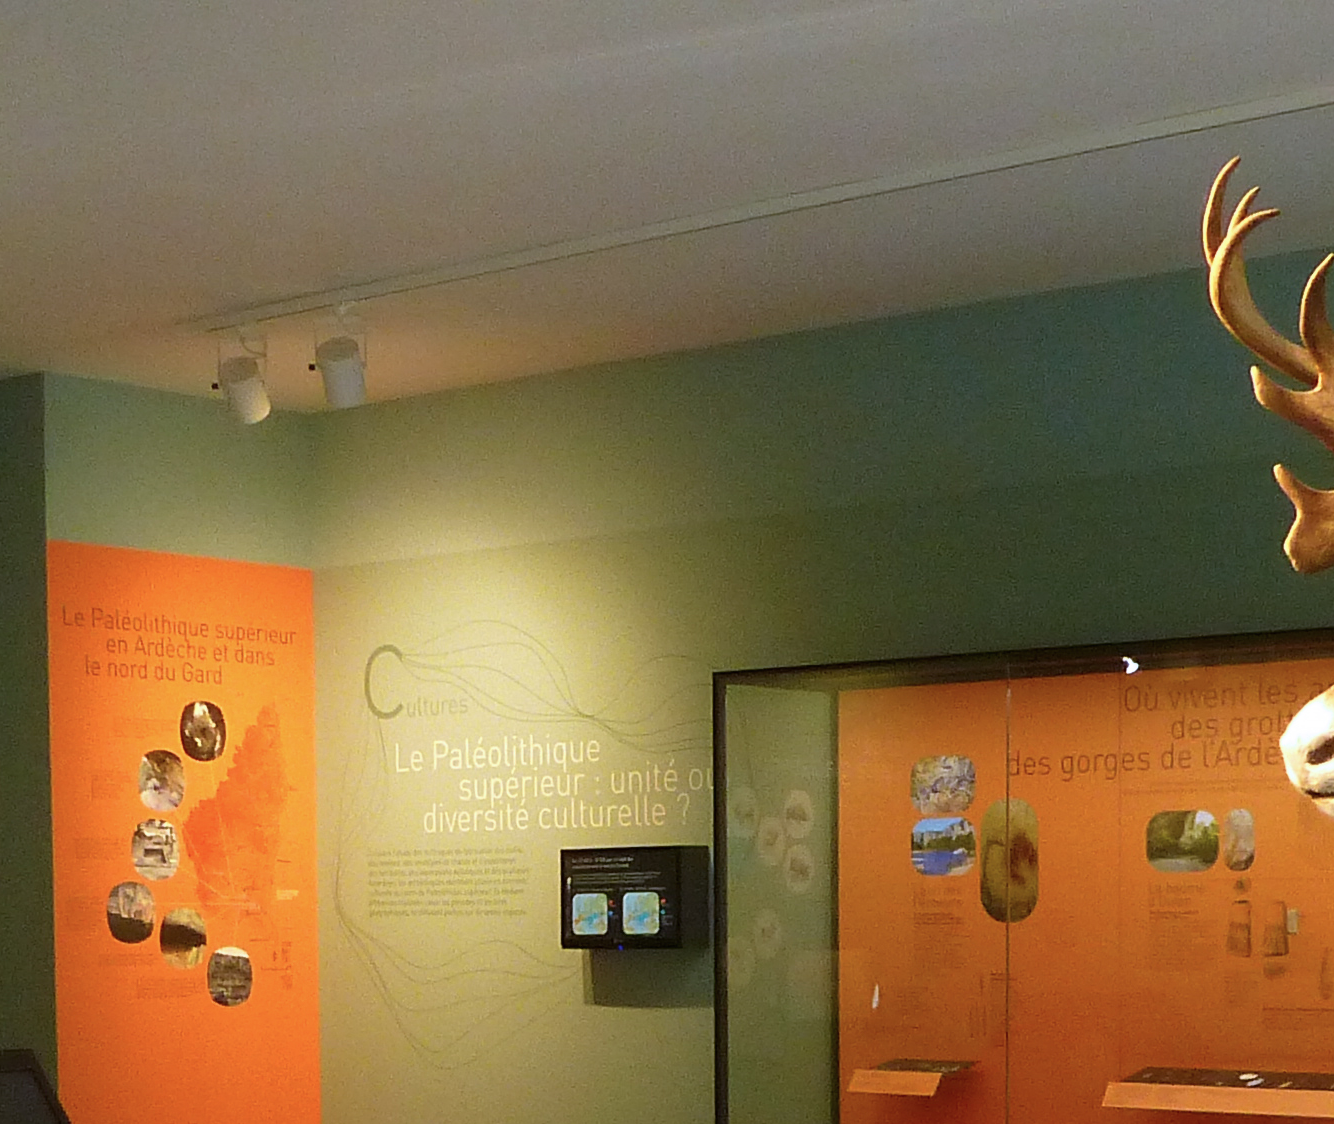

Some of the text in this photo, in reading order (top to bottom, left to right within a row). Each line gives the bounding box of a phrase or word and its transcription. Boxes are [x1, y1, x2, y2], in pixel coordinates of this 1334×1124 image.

[61, 605, 85, 628] Le
[91, 607, 209, 643] Paléolithique
[85, 654, 223, 686] le nord du Gard
[106, 636, 275, 667] en Ardèche et dans
[1123, 683, 1159, 713] Où
[1169, 682, 1248, 711] vivent
[1258, 681, 1299, 706] les
[1172, 714, 1219, 740] des
[395, 735, 601, 774] Le Paléolithique
[1009, 751, 1052, 777] des
[1060, 749, 1151, 783] gorges
[1161, 742, 1193, 770] de
[459, 767, 586, 808] supérieur
[611, 758, 679, 796] unité
[424, 793, 691, 834] diversité culturelle ?
